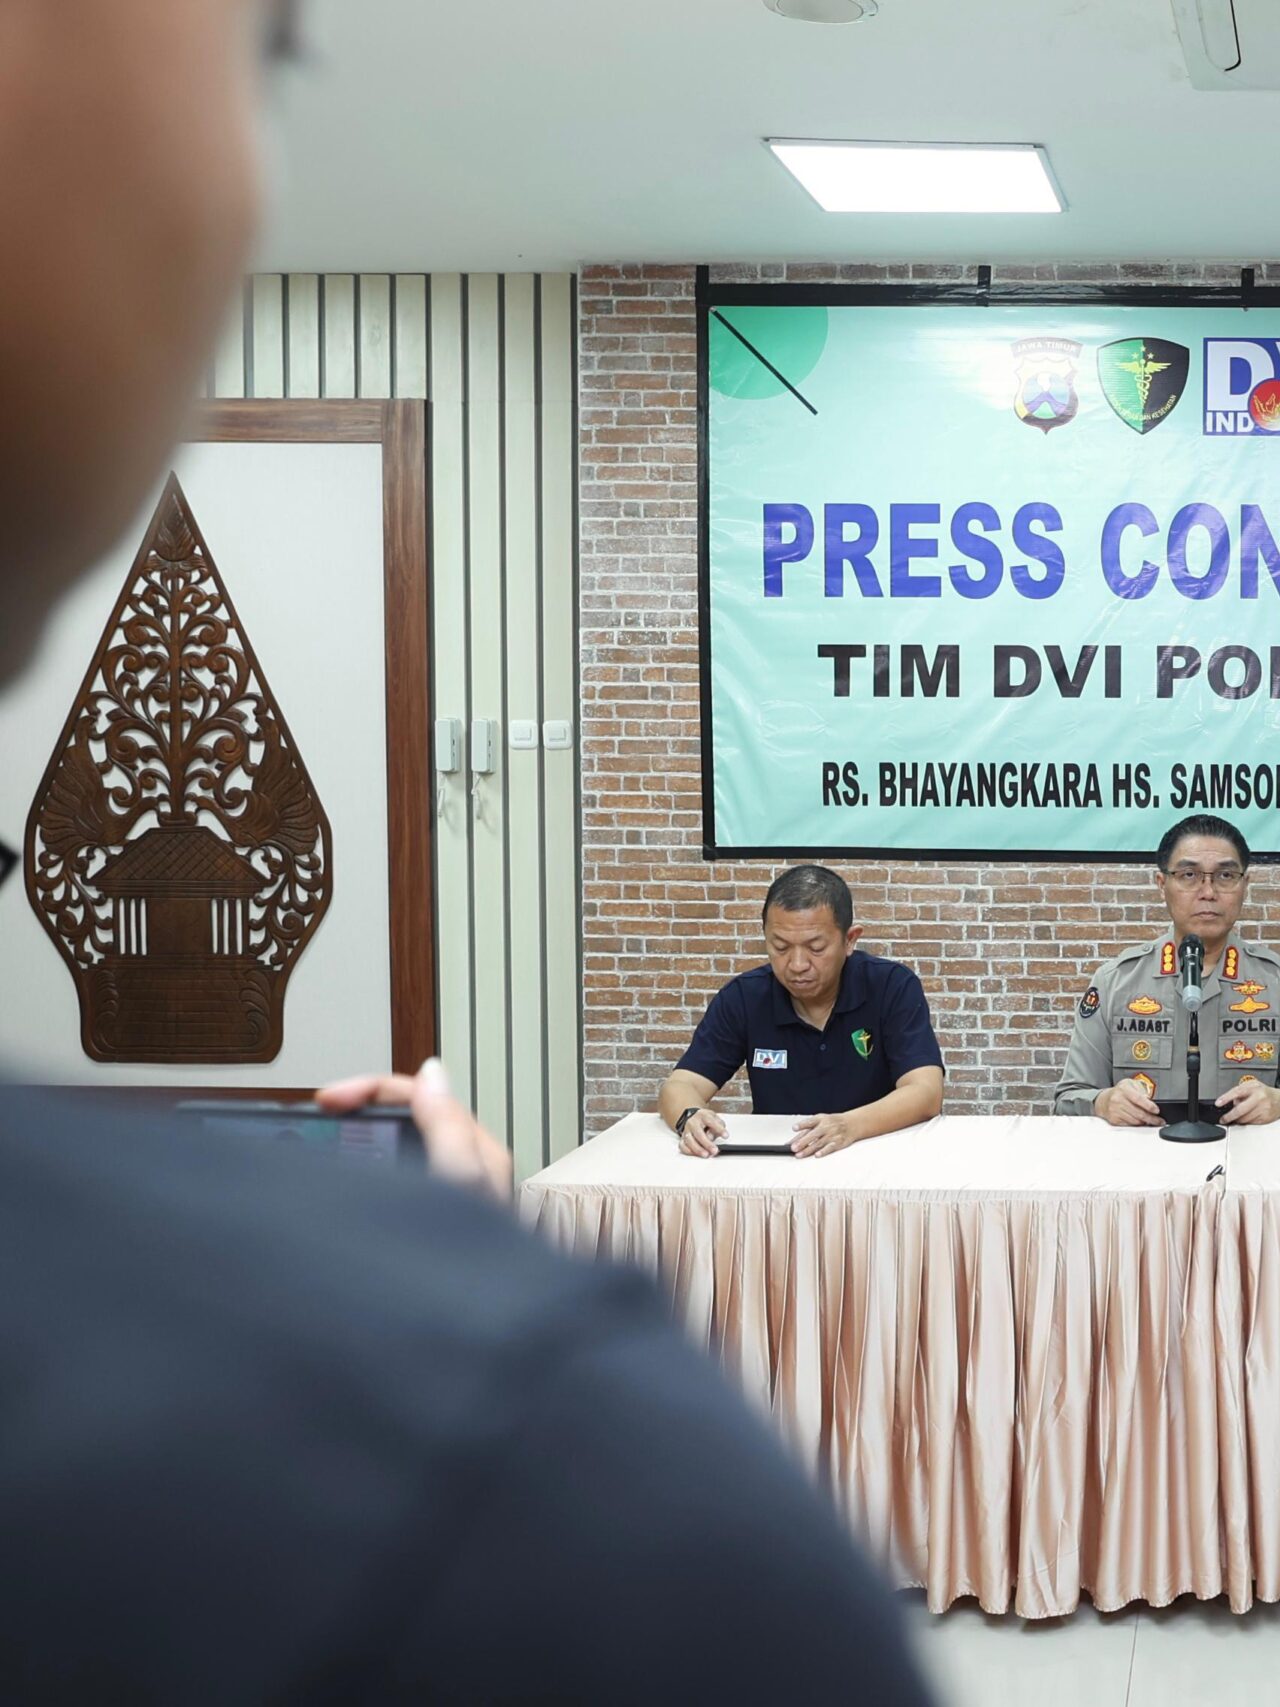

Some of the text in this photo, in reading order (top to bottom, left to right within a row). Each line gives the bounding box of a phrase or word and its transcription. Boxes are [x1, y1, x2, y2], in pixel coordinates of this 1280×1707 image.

[763, 502, 1065, 600] PRESS
[818, 644, 960, 698] TIM
[994, 645, 1122, 698] DVI
[822, 761, 869, 807] RS.
[878, 762, 1103, 808] BHAYANGKARA
[1112, 762, 1160, 809] HS.
[1222, 1018, 1276, 1033] POLRI
[756, 1052, 786, 1065] DVI
